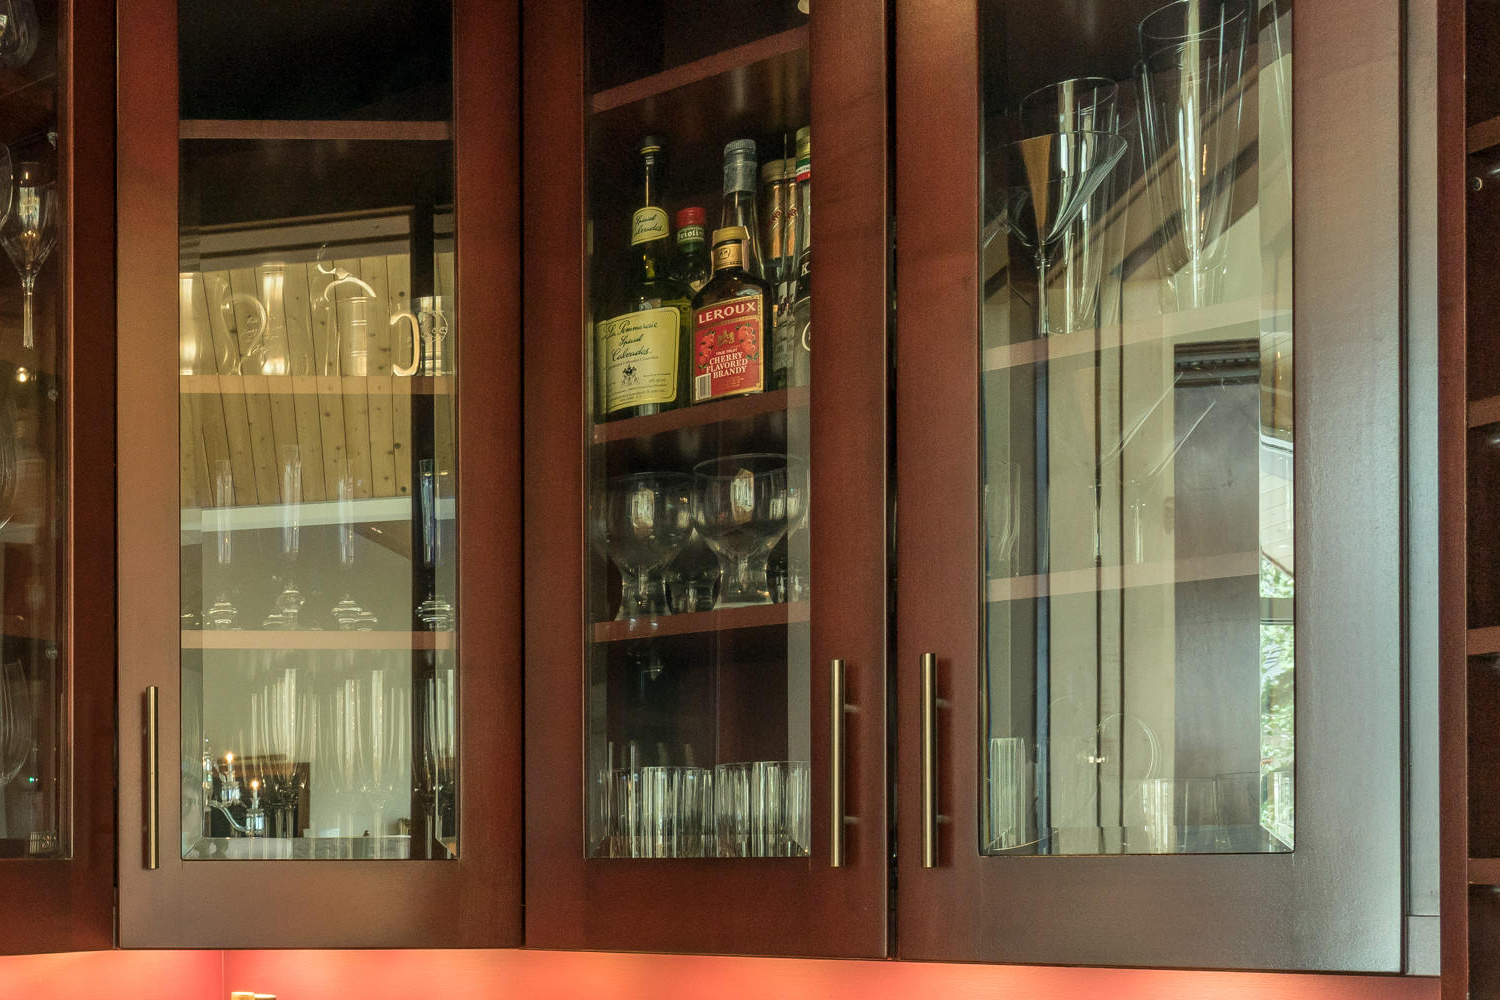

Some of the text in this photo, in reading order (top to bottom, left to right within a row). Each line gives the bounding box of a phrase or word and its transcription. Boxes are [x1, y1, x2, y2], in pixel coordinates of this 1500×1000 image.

[699, 302, 756, 324] LEROUX
[706, 358, 748, 374] FLAVORED
[709, 351, 743, 366] CHERRY
[713, 365, 747, 379] BRANDY
